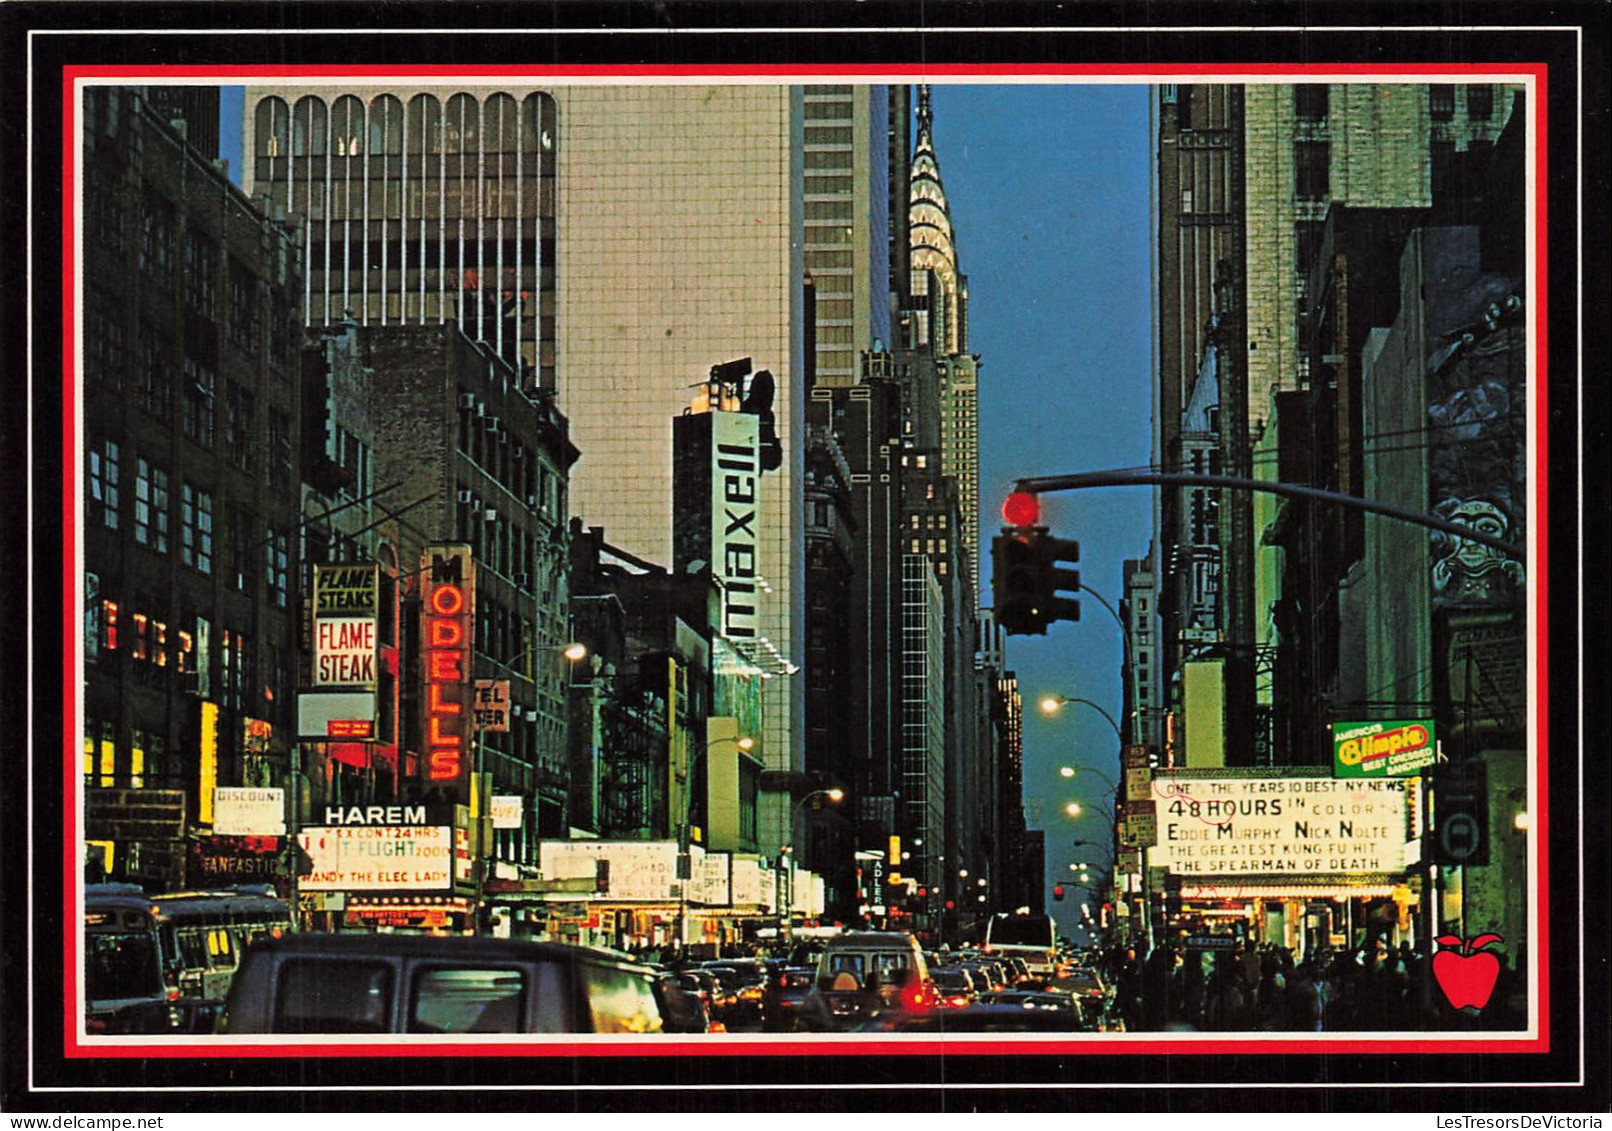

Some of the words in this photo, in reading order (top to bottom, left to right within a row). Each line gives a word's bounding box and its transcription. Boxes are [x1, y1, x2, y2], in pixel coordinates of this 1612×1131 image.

[716, 443, 756, 638] maxell
[318, 570, 374, 588] FLAME
[318, 590, 374, 609] STEAKS
[319, 622, 373, 650] FLAME
[319, 654, 373, 682] STEAK
[430, 554, 462, 780] MODELLS
[1338, 727, 1422, 766] Blimpie
[217, 790, 282, 801] DISCOUNT
[1166, 783, 1192, 795] ONE
[1210, 782, 1237, 794] THE
[1241, 782, 1286, 794] YEARS
[1305, 781, 1337, 792] BEST
[1346, 781, 1365, 791] NY
[1368, 780, 1405, 792] NEWS
[325, 806, 426, 825] HAREM
[1168, 799, 1201, 818] 48
[1207, 798, 1282, 816] HOURS
[1312, 804, 1374, 815] COLOR
[357, 828, 392, 839] CONT
[394, 827, 411, 838] 24
[413, 828, 440, 838] HRS
[359, 839, 415, 857] FLIGHT
[1168, 845, 1195, 856] THE
[1200, 844, 1276, 855] GREATEST
[1283, 843, 1322, 854] KUNG
[1328, 843, 1347, 854] FU
[1353, 842, 1375, 853] HIT
[1175, 860, 1201, 872] THE
[1210, 860, 1296, 871] SPEARMAN
[1304, 859, 1322, 870] OF
[1329, 858, 1379, 869] DEATH
[351, 872, 374, 883] THE
[377, 871, 408, 882] ELEC
[415, 871, 448, 882] LADY
